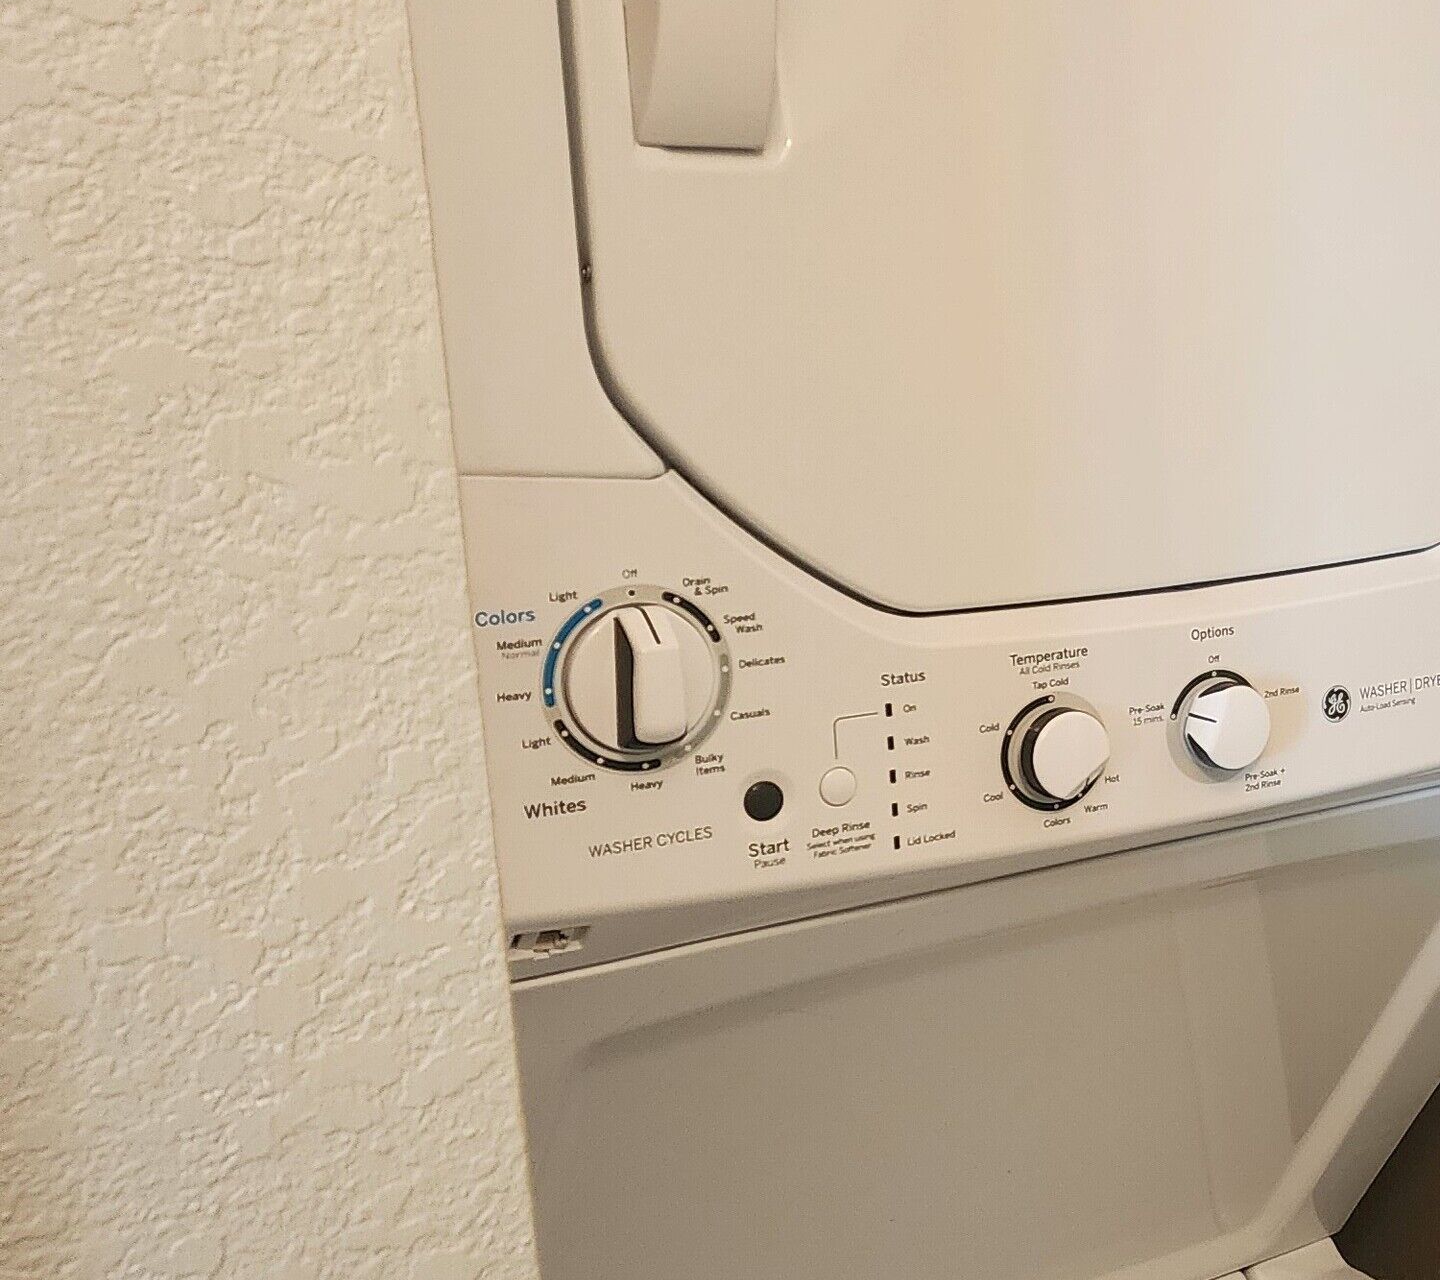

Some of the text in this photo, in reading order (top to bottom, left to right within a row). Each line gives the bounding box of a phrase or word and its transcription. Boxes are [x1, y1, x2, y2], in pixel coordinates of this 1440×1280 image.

[622, 568, 638, 579] Off
[682, 577, 711, 587] Drain
[548, 590, 578, 603] Light
[705, 586, 729, 596] Spin
[475, 610, 536, 628] Colors
[723, 613, 756, 625] Speed
[735, 622, 763, 634] Wash
[1190, 625, 1235, 642] Options
[496, 638, 542, 651] Medium
[738, 655, 786, 669] Delicates
[1009, 646, 1088, 667] Temperature
[1208, 654, 1220, 664] Off
[1032, 664, 1051, 675] Cold
[1053, 660, 1080, 671] Rinses
[880, 671, 926, 687] Status
[1032, 676, 1069, 690] Tap Cold
[496, 691, 532, 702] Heavy
[1264, 685, 1300, 699] 2nd Rinse
[1359, 680, 1407, 700] WASHER
[730, 707, 771, 721] Casuals
[903, 703, 917, 713] On
[1128, 702, 1165, 716] Pre-Soak
[979, 722, 1000, 734] Cold
[1133, 716, 1143, 727] 15
[521, 736, 551, 750] Light
[904, 735, 930, 746] Wash
[695, 752, 724, 765] Bulky
[695, 764, 725, 776] Items
[904, 770, 931, 780] Rinse
[1244, 768, 1278, 782] Pre-Soak
[551, 772, 596, 787] Medium
[630, 779, 663, 792] Heavy
[1104, 774, 1120, 784] Hot
[1245, 778, 1281, 792] 2nd Rinse
[983, 791, 1004, 803] Cool
[523, 798, 587, 820] Whites
[907, 803, 928, 814] Spin
[1084, 802, 1109, 813] Warm
[1043, 816, 1072, 829] Colors
[812, 820, 871, 839] Deep Rinse
[588, 826, 714, 858] WASHER CYCLES
[907, 830, 956, 847] Lid Locked
[748, 837, 790, 858] Start
[754, 856, 786, 869] Pause
